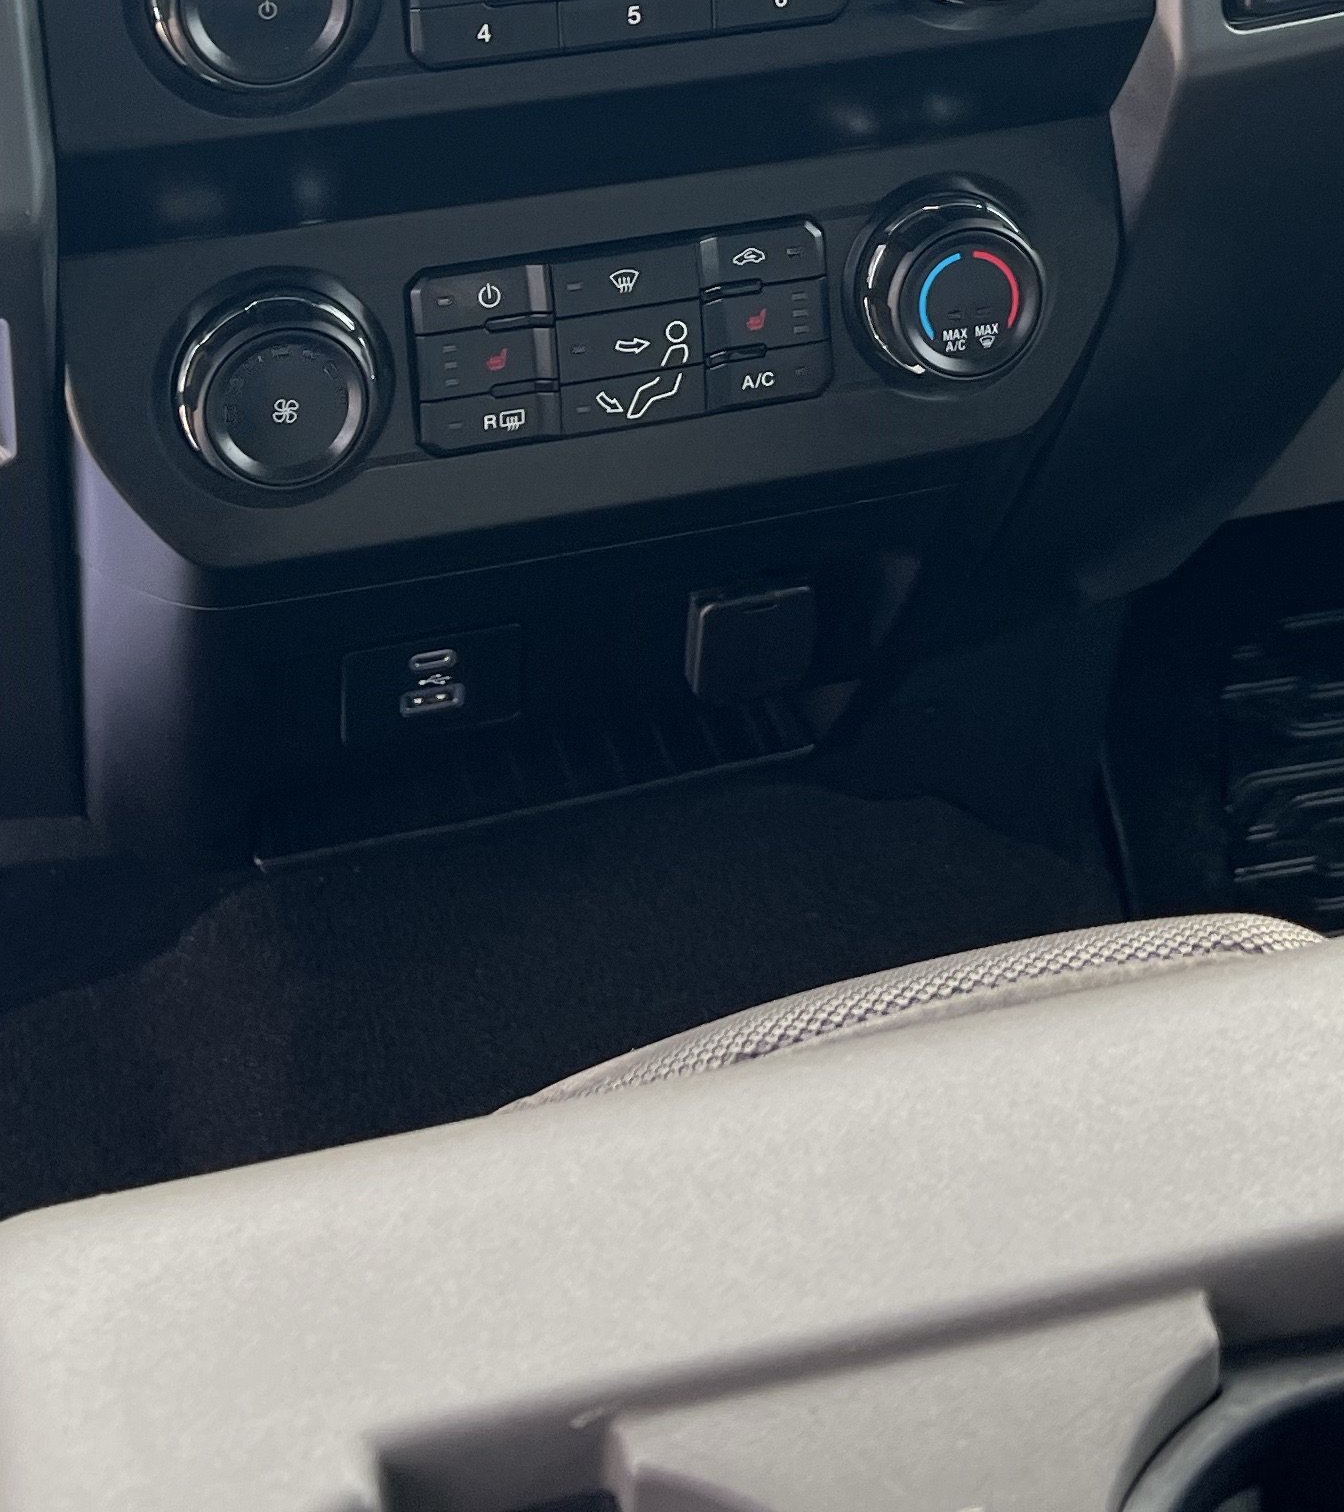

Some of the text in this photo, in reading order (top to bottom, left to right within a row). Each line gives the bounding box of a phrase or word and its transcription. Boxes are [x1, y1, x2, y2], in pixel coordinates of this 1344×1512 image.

[626, 4, 642, 26] 5
[476, 23, 492, 44] 4
[942, 327, 968, 342] MAX
[974, 322, 999, 338] MAX
[945, 339, 967, 353] A/C
[741, 371, 776, 391] A/C
[483, 414, 497, 431] R
